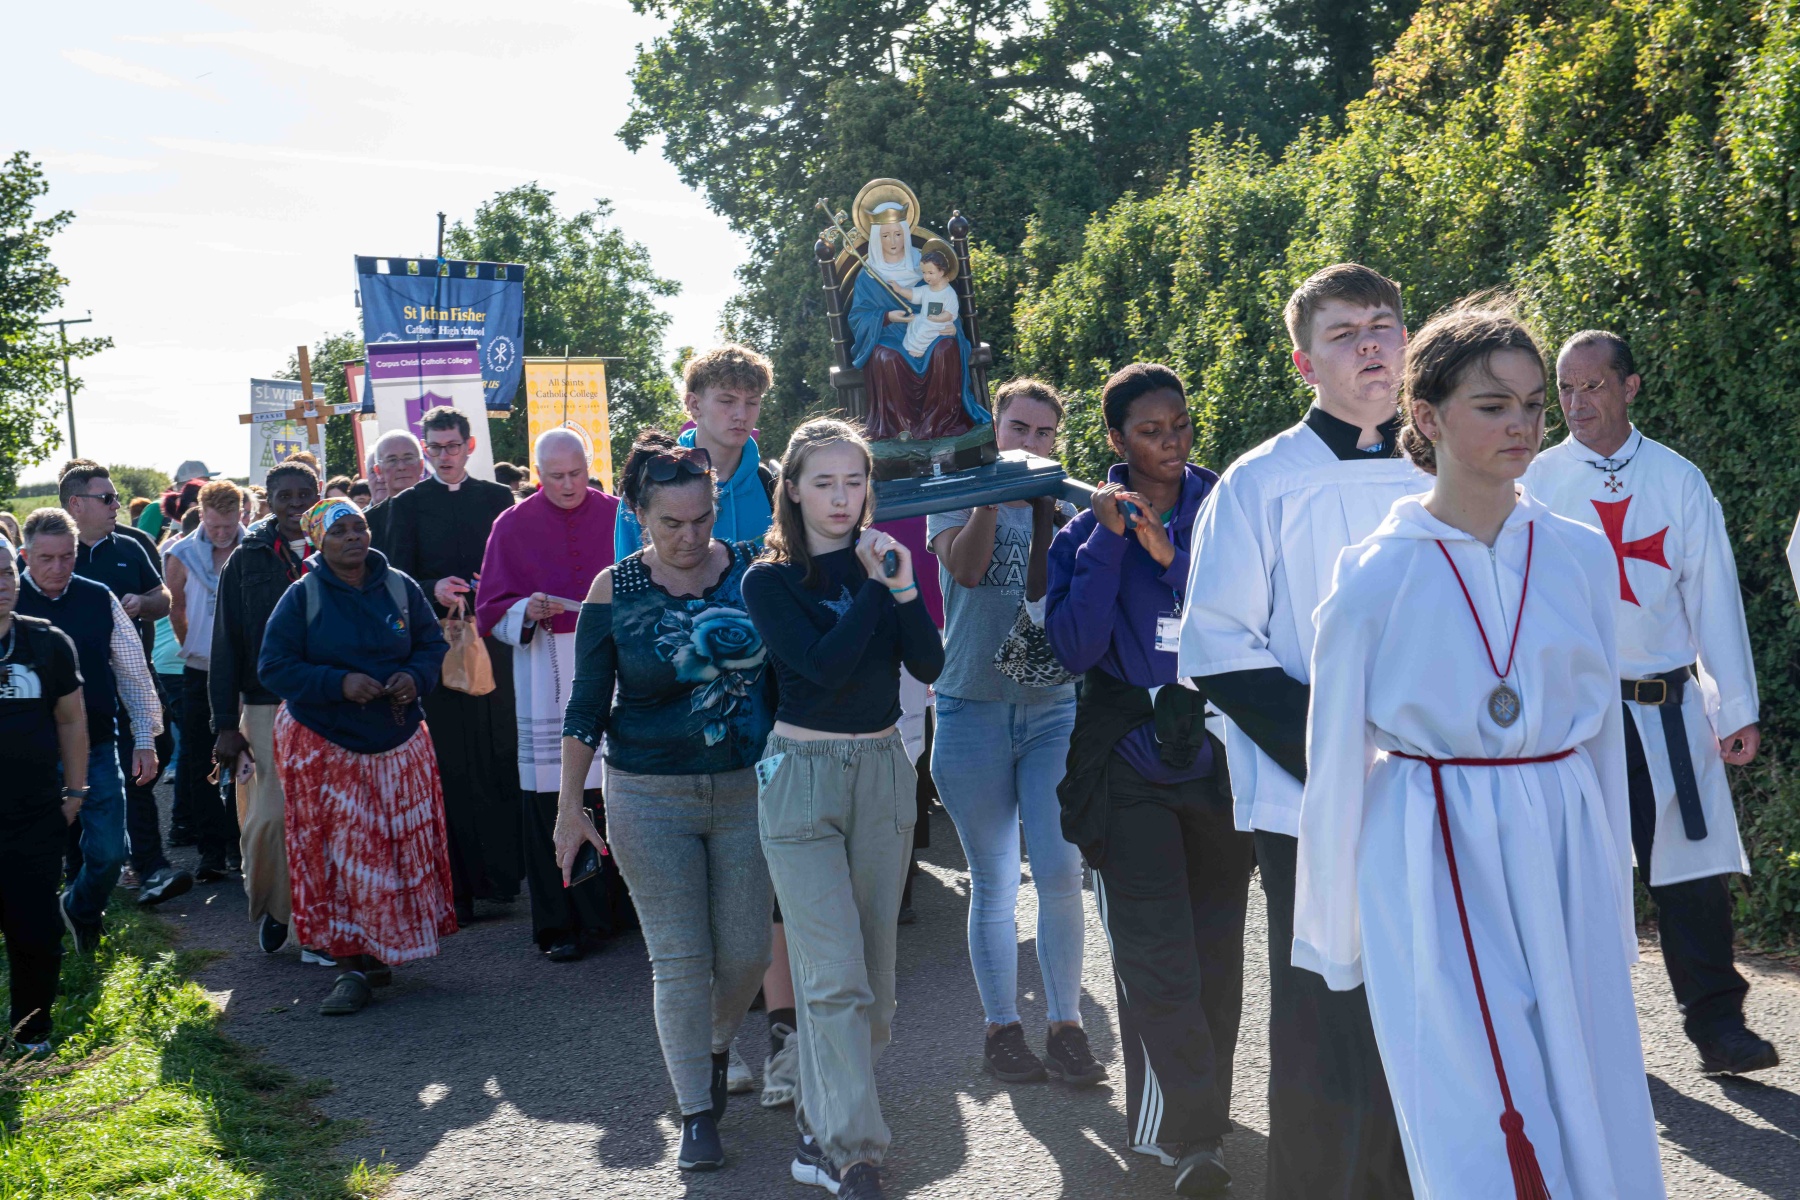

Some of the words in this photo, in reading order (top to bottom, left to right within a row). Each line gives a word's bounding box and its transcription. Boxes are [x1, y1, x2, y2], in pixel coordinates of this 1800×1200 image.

[403, 305, 418, 320] St
[420, 305, 449, 323] John
[450, 307, 486, 322] Fisher
[438, 325, 460, 338] High
[461, 325, 485, 336] School
[376, 360, 400, 369] Corpus
[421, 358, 447, 366] Catholic
[447, 357, 473, 365] College
[548, 378, 560, 387] All
[561, 378, 584, 387] Saints
[255, 383, 270, 400] St
[535, 390, 567, 398] Catholic
[569, 390, 598, 400] College
